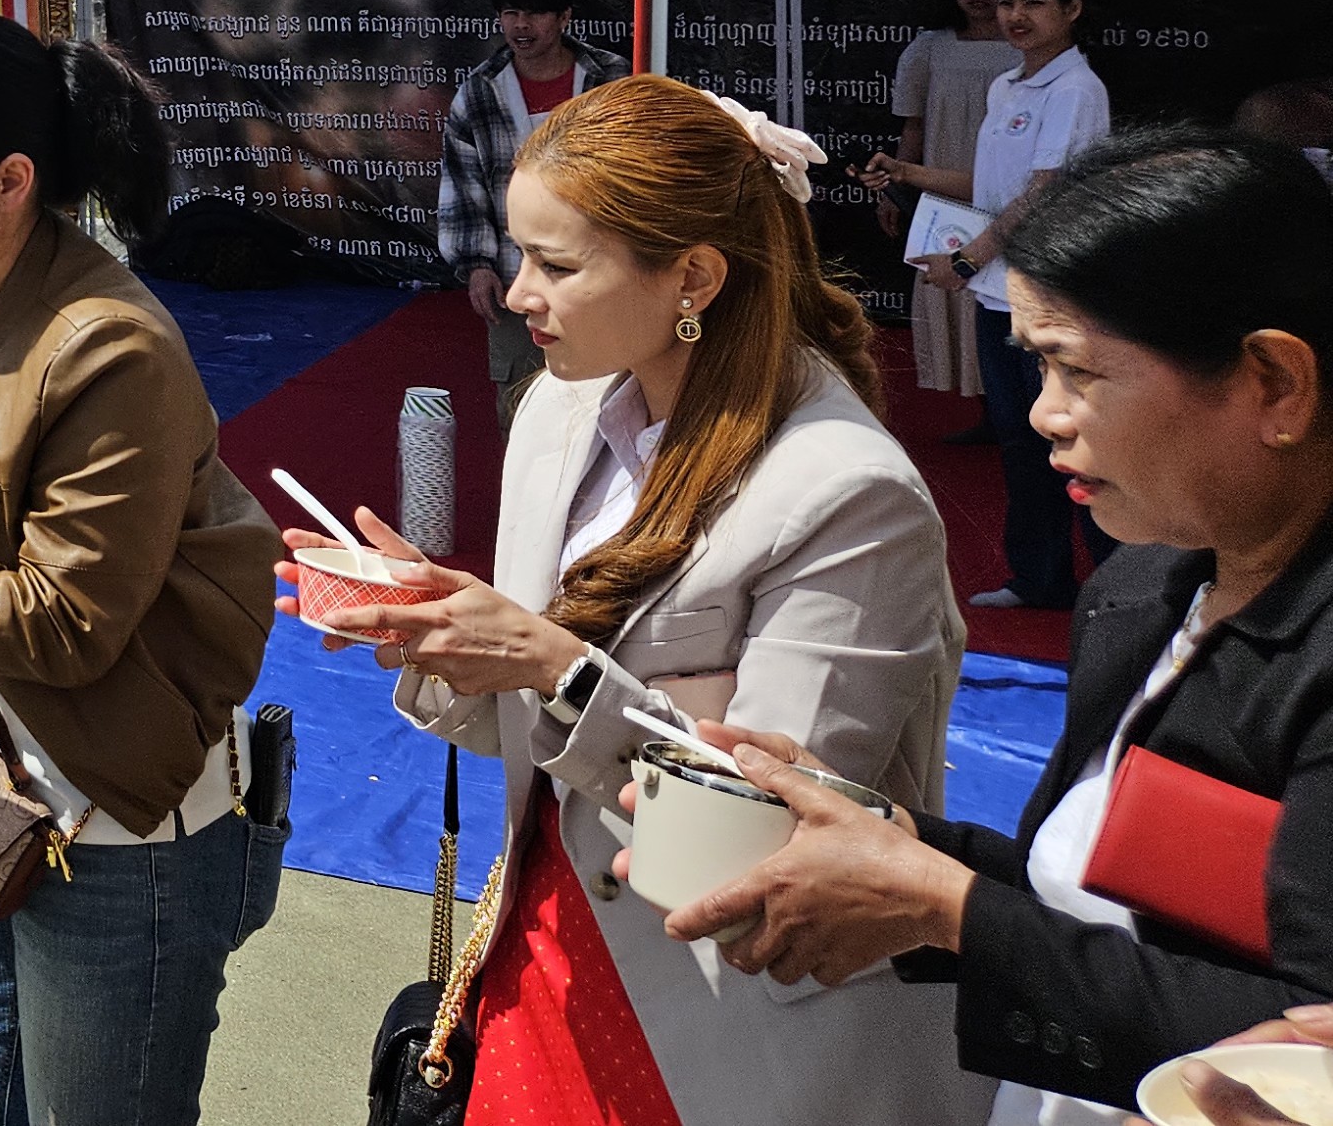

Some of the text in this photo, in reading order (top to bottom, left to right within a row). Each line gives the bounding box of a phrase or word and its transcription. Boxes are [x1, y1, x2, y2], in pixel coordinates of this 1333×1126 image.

[308, 16, 352, 32] ណាត
[1135, 26, 1209, 49] ១៩៦០
[171, 145, 293, 171] ម្តេចព្រះសង្ឃរាជ
[338, 238, 382, 257] ណាត
